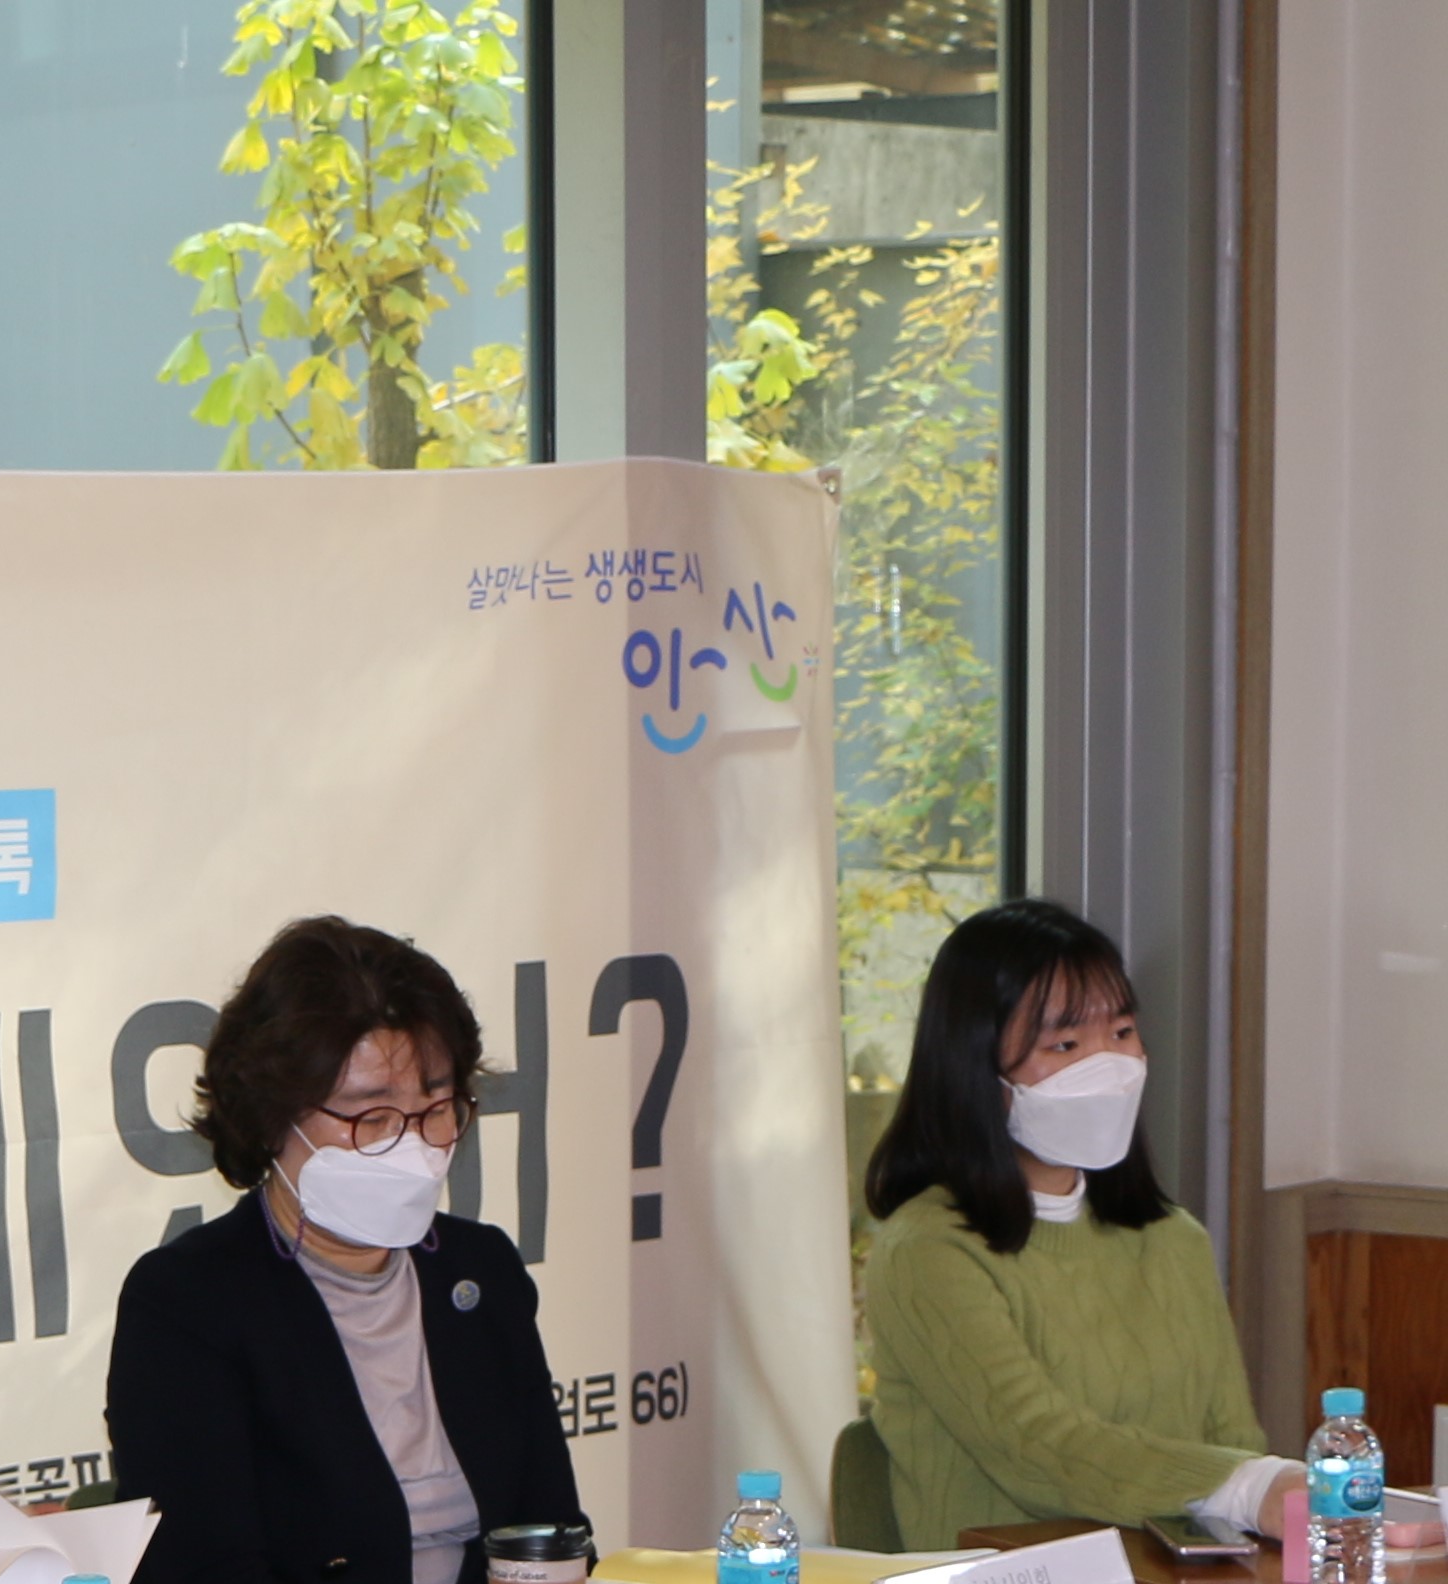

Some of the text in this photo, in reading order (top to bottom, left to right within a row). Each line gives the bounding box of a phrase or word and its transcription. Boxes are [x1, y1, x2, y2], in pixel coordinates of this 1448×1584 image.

[467, 549, 704, 610] 살맛나는 생생도시
[631, 1360, 689, 1425] 66)
